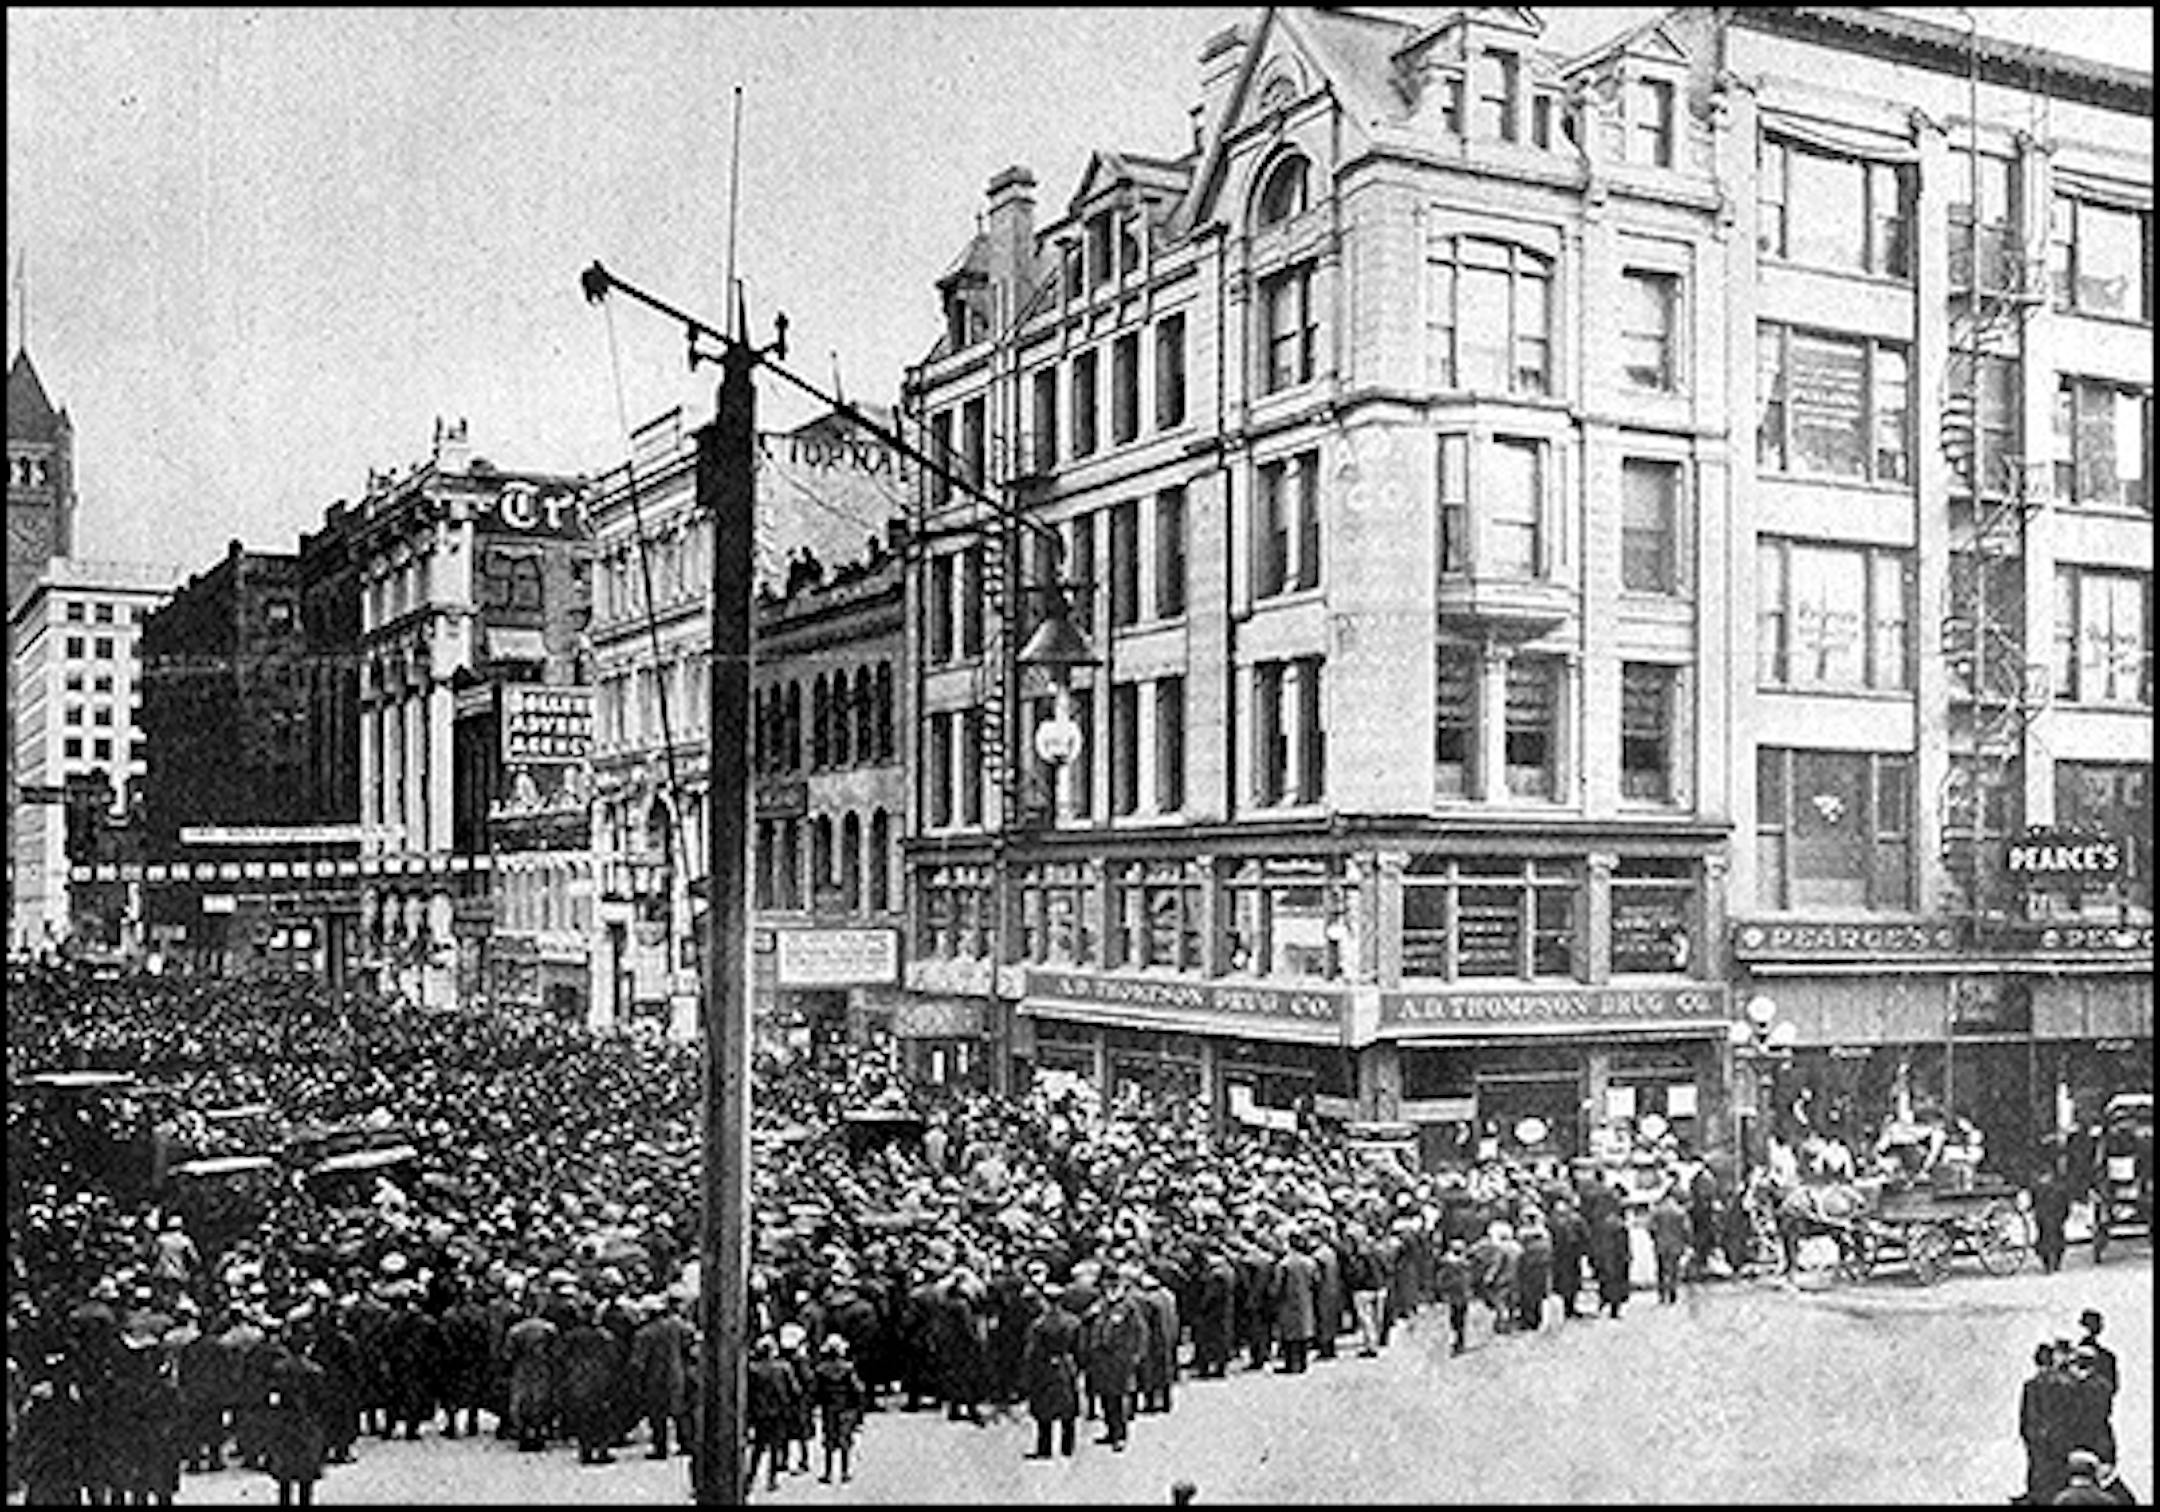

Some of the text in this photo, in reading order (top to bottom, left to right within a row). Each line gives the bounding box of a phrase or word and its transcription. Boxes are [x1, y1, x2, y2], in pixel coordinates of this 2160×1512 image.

[2008, 844, 2119, 871] PEARCE'S
[1449, 993, 1589, 1019] THOMPSON
[1600, 991, 1664, 1014] DRUG
